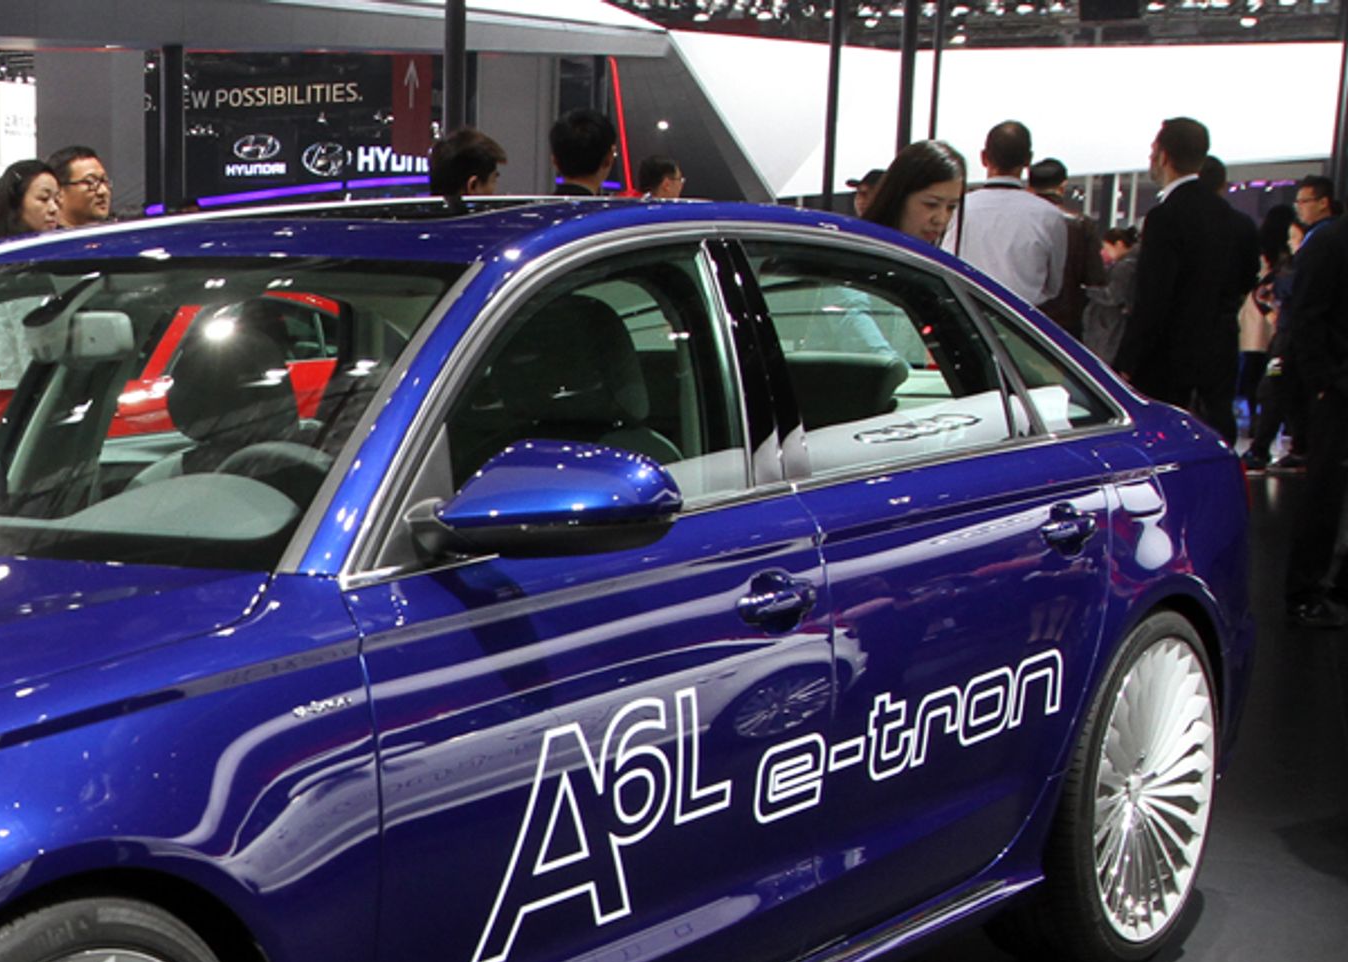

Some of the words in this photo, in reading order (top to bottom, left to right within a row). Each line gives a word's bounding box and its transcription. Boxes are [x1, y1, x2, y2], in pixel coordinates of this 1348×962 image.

[215, 82, 363, 108] POSSIBILITIES.
[225, 162, 286, 177] HYUNDAI
[752, 648, 1063, 824] e-tron
